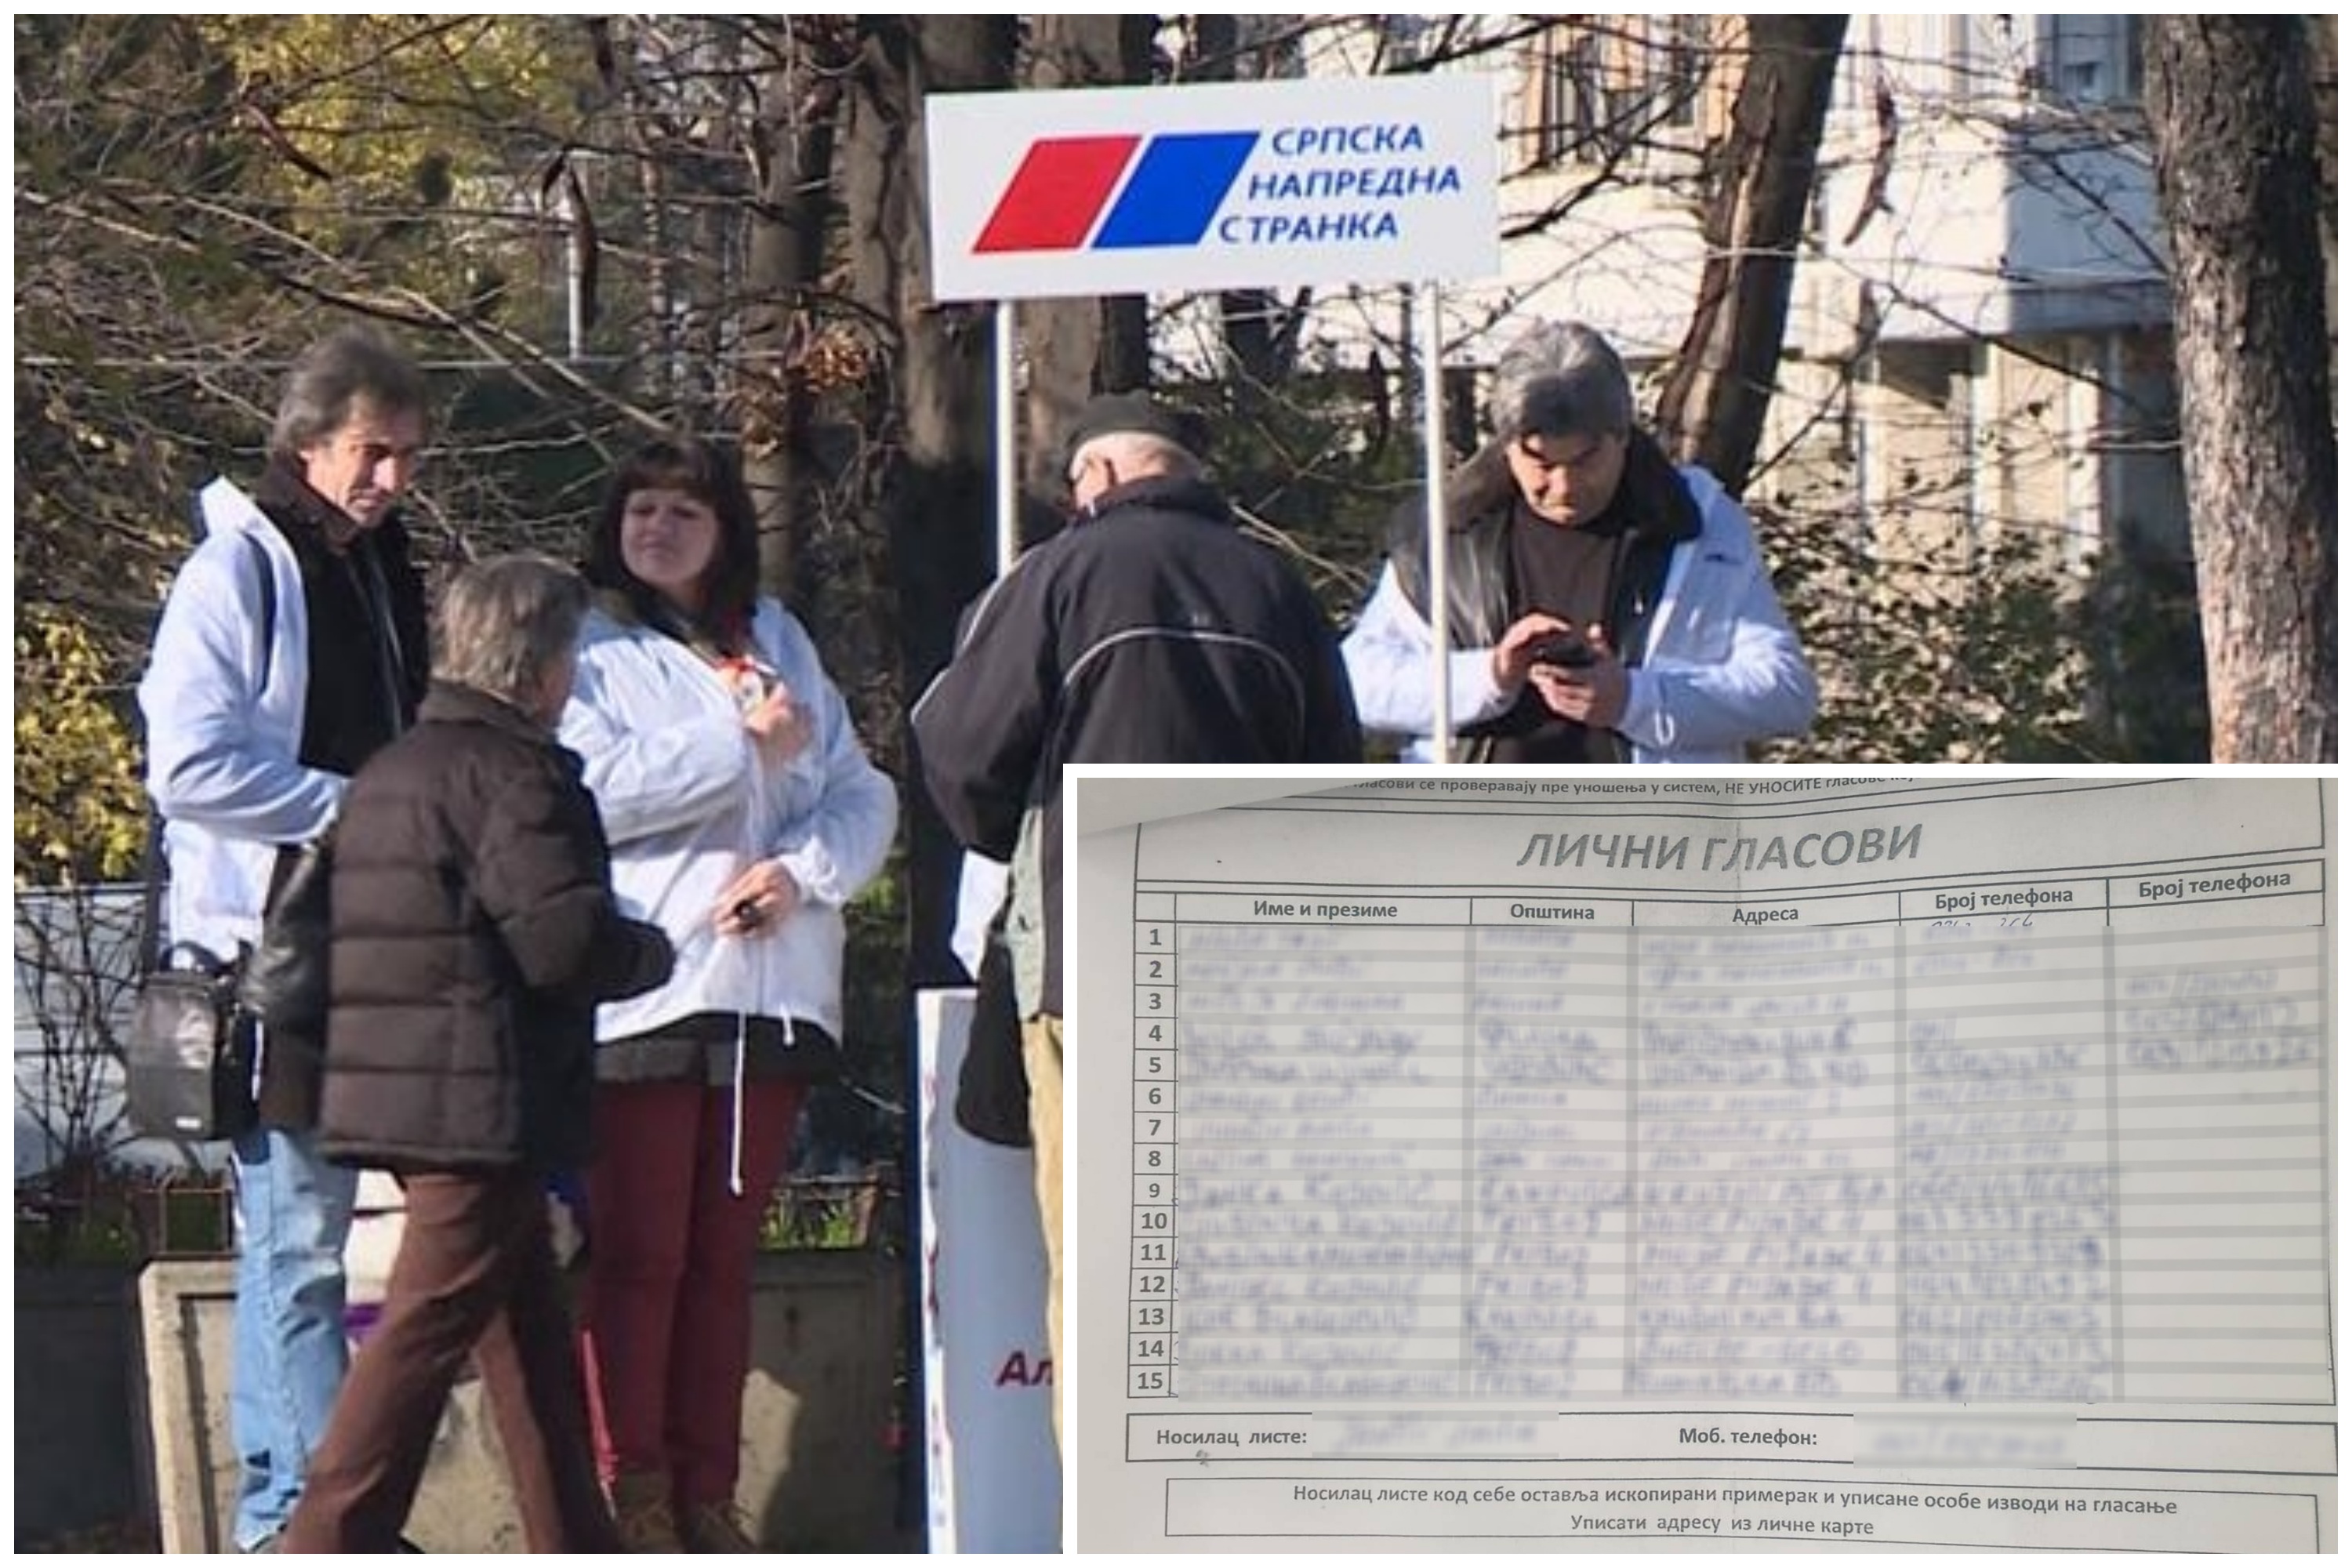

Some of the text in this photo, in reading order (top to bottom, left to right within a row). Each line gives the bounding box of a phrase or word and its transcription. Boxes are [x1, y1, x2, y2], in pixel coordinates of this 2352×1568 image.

[1272, 125, 1423, 155] СРПСКА
[1248, 166, 1460, 200] НАПРЕДНА
[1219, 212, 1398, 243] СТРАНКА
[1419, 781, 1436, 790] се
[1440, 781, 1537, 795] проверавају
[1541, 783, 1569, 795] пре
[1573, 784, 1646, 796] уношења
[1650, 784, 1660, 795] у
[1663, 783, 1721, 797] систем,
[1725, 782, 1744, 795] НЕ
[1748, 777, 1822, 794] УНОСИТЕ
[1516, 823, 1923, 872] ЛИЧНИ ГЛАСОВИ
[2138, 872, 2292, 901] Број телефона
[1935, 886, 2074, 913] Број телефона
[1254, 900, 1398, 920] Име и презиме
[1510, 903, 1595, 920] Општина
[1731, 907, 1799, 926] Адреса
[1149, 928, 1162, 946] 1
[1149, 960, 1163, 978] 2
[1149, 993, 1162, 1010] 3
[1149, 1024, 1163, 1042] 4
[1149, 1056, 1162, 1073] 5
[1149, 1087, 1162, 1105] 6
[1149, 1119, 1162, 1136] 7
[1148, 1150, 1162, 1167] 8
[1149, 1182, 1160, 1198] 9
[1142, 1212, 1167, 1229] 10
[1141, 1243, 1167, 1261] 11
[1139, 1276, 1166, 1293] 12
[1138, 1308, 1164, 1326] 13
[1138, 1340, 1164, 1357] 14
[1138, 1372, 1163, 1390] 15
[1156, 1429, 1307, 1447] Носилац листе:
[1679, 1427, 1817, 1448] Моб. телефон:
[1294, 1485, 2177, 1515] Носилац листе код себе оставља ископирани примерак и уписане особе изводи на гласање
[1570, 1515, 1875, 1537] Уписати адресу из личне карте
